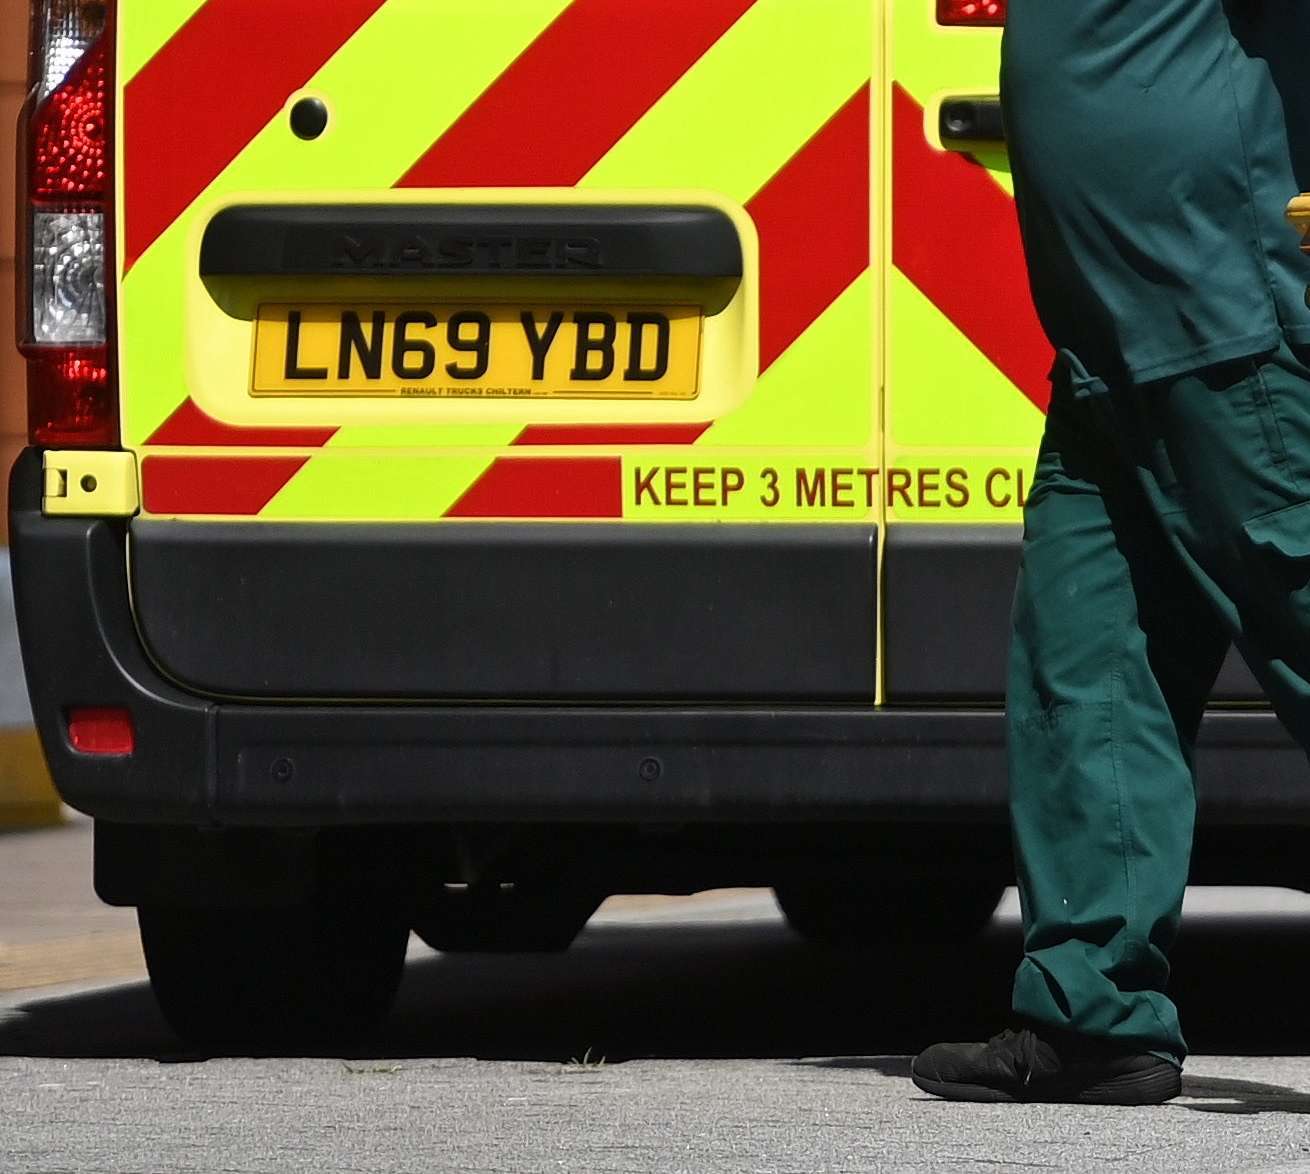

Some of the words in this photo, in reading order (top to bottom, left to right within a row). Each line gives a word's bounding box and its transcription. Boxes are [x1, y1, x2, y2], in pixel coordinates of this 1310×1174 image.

[331, 233, 604, 270] MASTER
[283, 309, 492, 380] LN69
[519, 310, 671, 382] YBD
[400, 387, 442, 396] RENAULT
[446, 387, 483, 396] TRUCKS
[485, 387, 532, 396] CHILTERN
[633, 466, 746, 507] KEEP
[759, 467, 781, 508] 3
[796, 467, 970, 509] METRES
